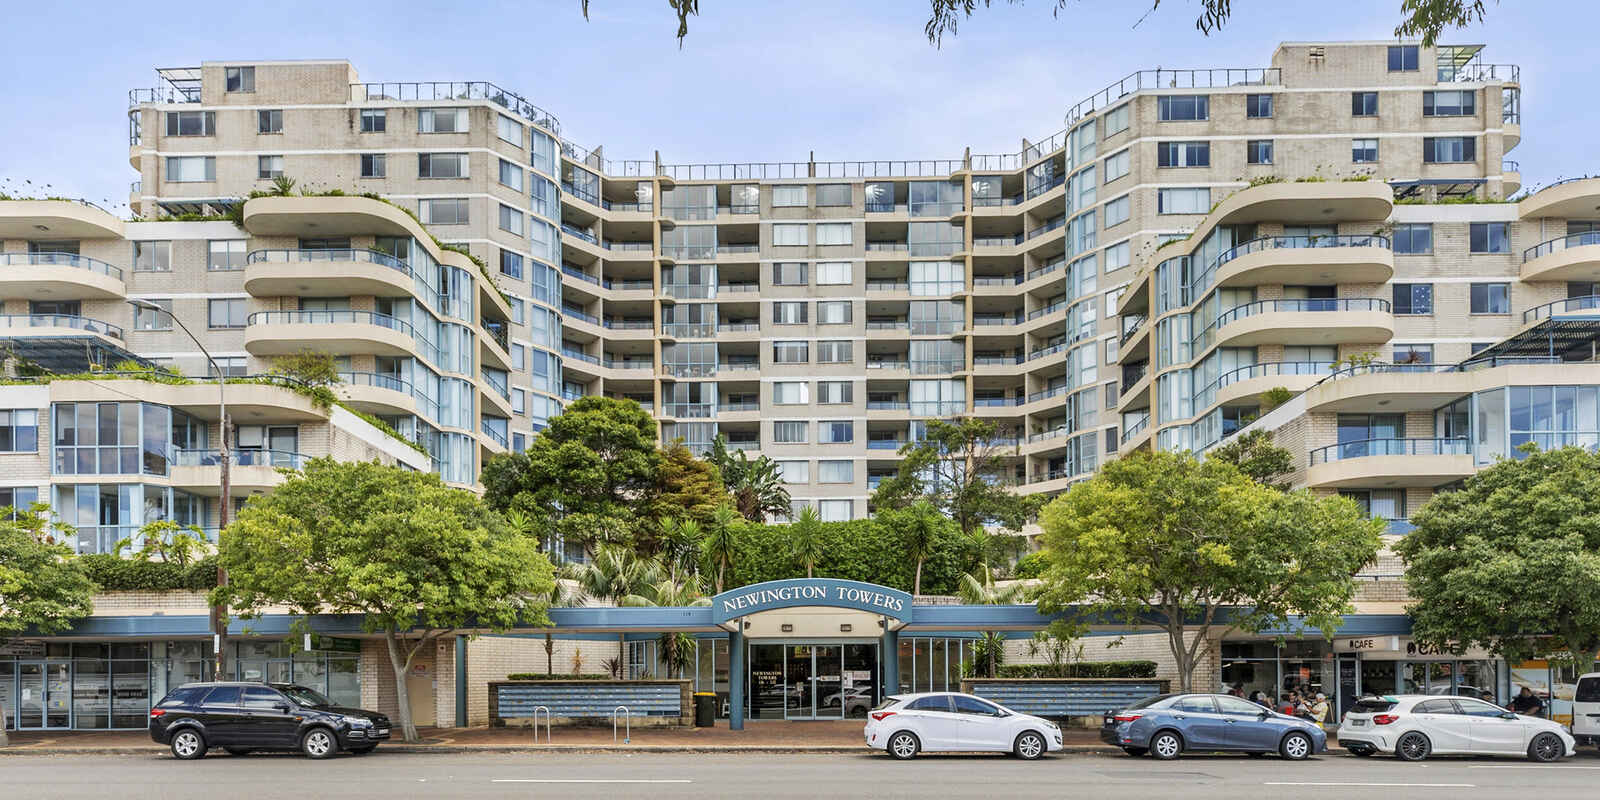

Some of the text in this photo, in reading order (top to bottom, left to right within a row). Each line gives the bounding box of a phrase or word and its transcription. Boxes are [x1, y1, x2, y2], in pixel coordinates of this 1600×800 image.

[723, 586, 904, 612] NEWINGTON TOWERS
[1354, 639, 1374, 649] CAFE
